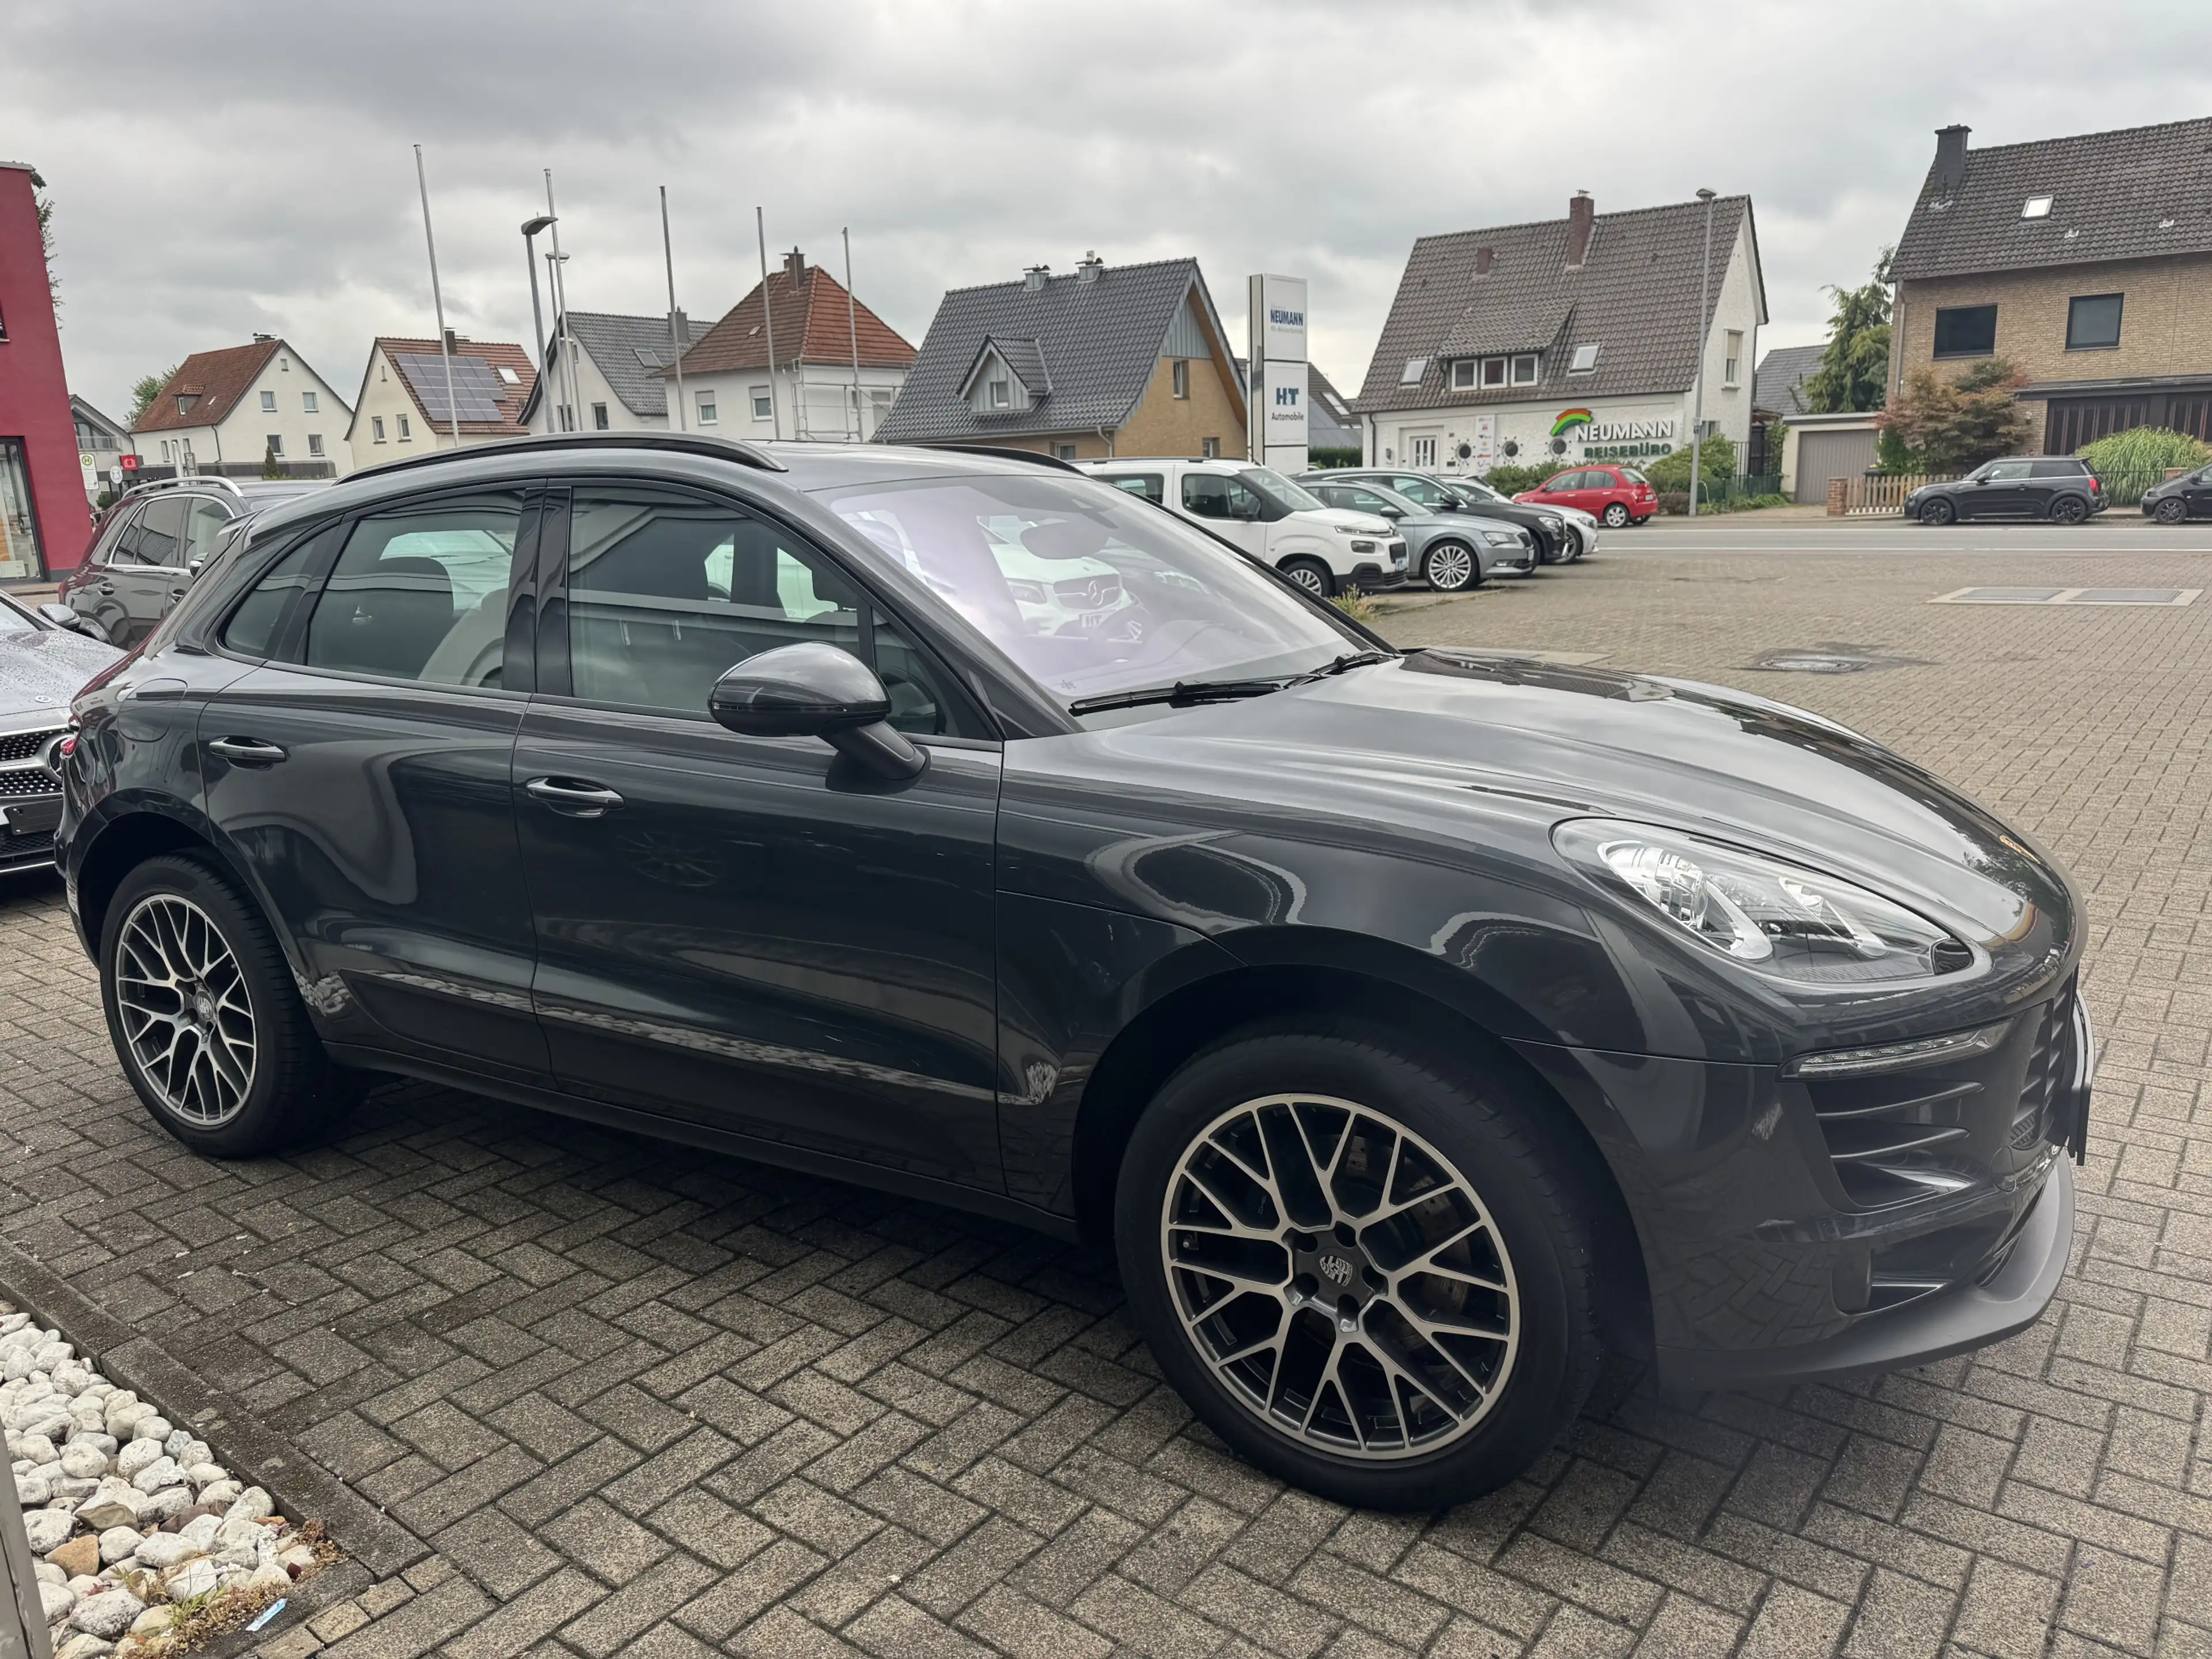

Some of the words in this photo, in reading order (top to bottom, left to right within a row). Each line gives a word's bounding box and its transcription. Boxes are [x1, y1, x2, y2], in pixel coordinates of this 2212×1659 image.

[1271, 309, 1303, 326] NEUMANN
[1271, 412, 1304, 421] Automobile
[1575, 421, 1673, 442] NEUMANN
[1585, 442, 1672, 458] REISEBÜRO
